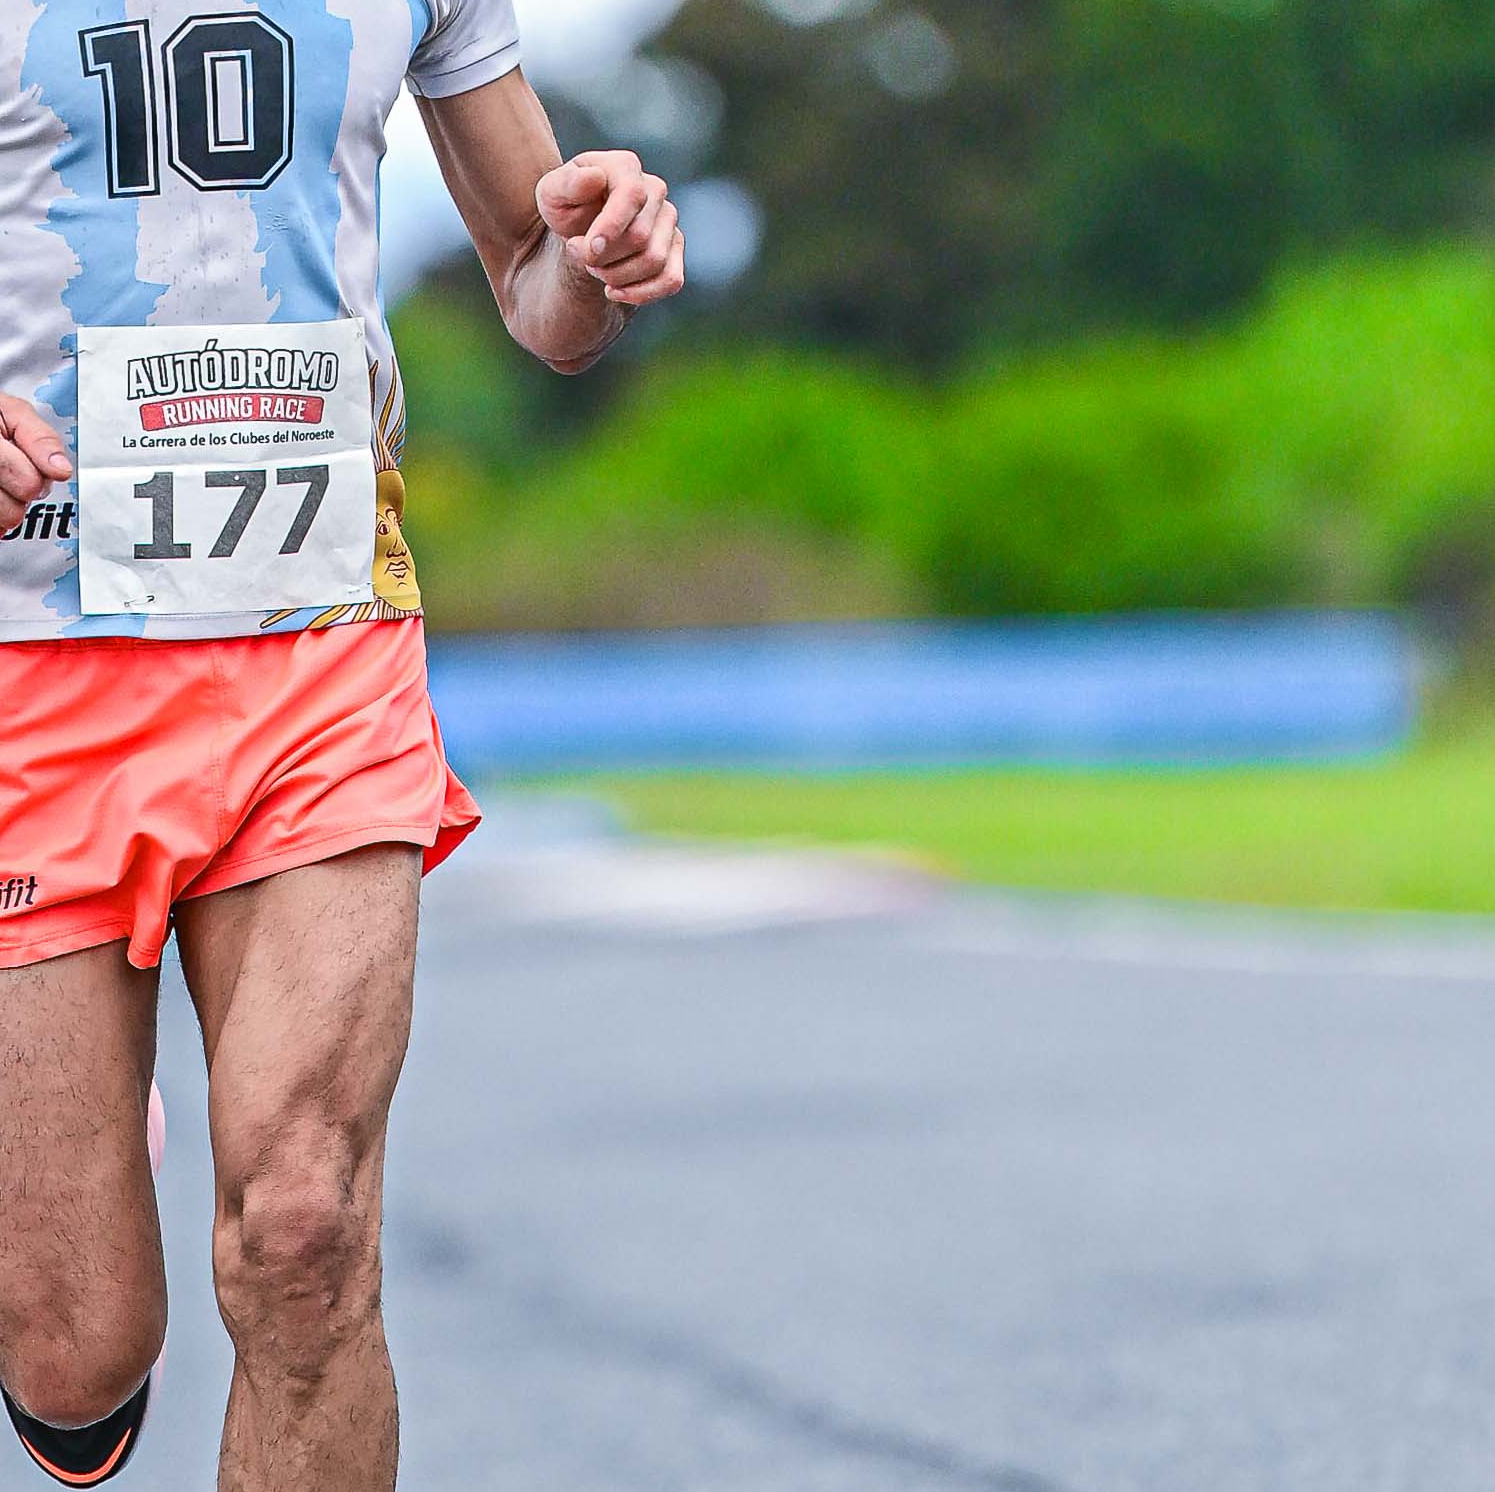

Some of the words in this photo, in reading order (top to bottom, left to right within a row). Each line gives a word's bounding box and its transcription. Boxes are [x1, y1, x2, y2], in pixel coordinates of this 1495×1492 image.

[78, 10, 294, 199] 10
[126, 338, 340, 401] AUTÓDROMO
[122, 436, 137, 448] La
[139, 435, 187, 448] Carrera
[189, 433, 206, 446] de
[209, 432, 227, 446] los
[229, 431, 270, 445] Clubes
[272, 429, 289, 443] del
[291, 428, 335, 443] Noroeste
[161, 396, 253, 426] RUNNING
[259, 396, 307, 421] RACE
[133, 464, 330, 560] 177
